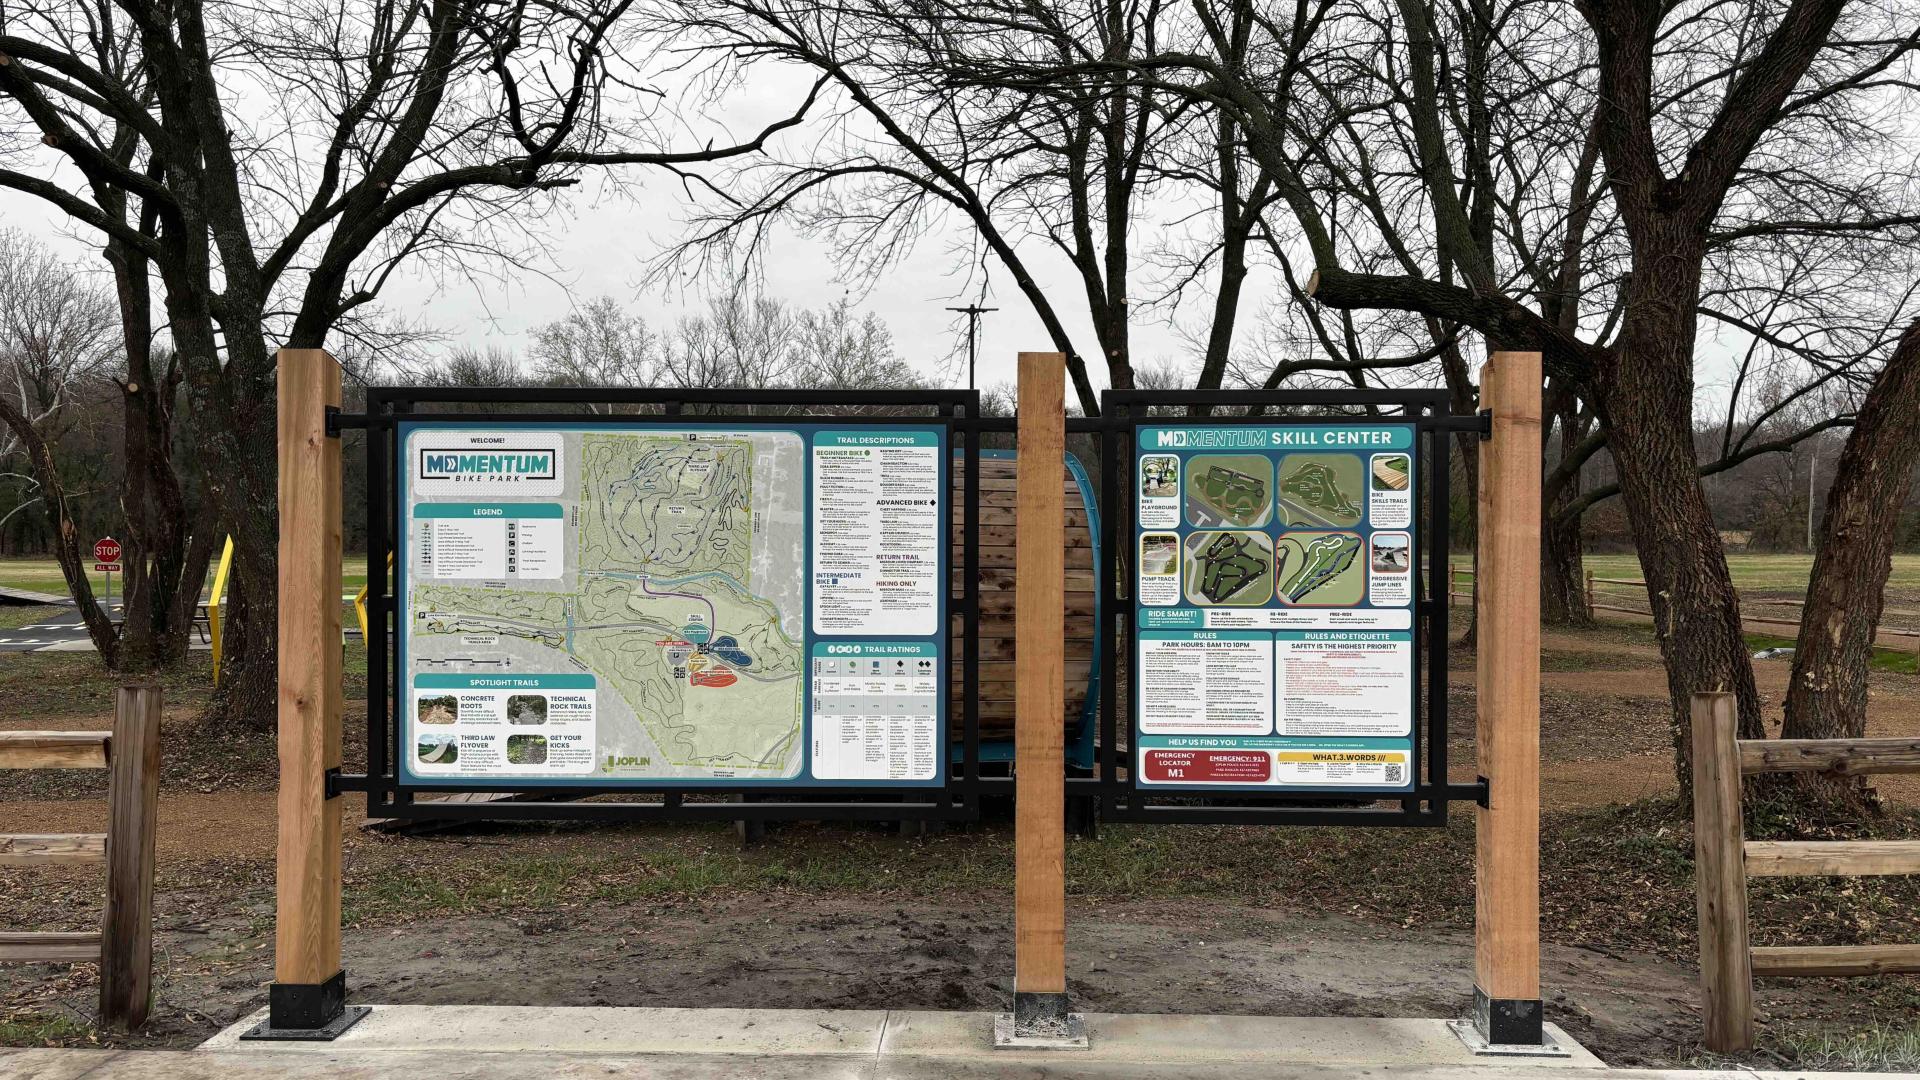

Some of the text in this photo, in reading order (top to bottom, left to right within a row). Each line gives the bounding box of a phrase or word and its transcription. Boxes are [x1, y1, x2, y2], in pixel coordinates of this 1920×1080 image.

[1158, 430, 1392, 447] MOMENTUM SKILL CENTER
[427, 455, 549, 474] MOMENTUM
[473, 508, 503, 516] LEGEND
[95, 546, 120, 556] STOP
[1348, 633, 1390, 641] ETIQUETTE
[470, 679, 539, 687] SPOTLIGHT TRAILS
[615, 756, 651, 766] JOPLIN
[1312, 753, 1376, 761] WHAT.3.WORDS
[1168, 768, 1185, 777] M1
